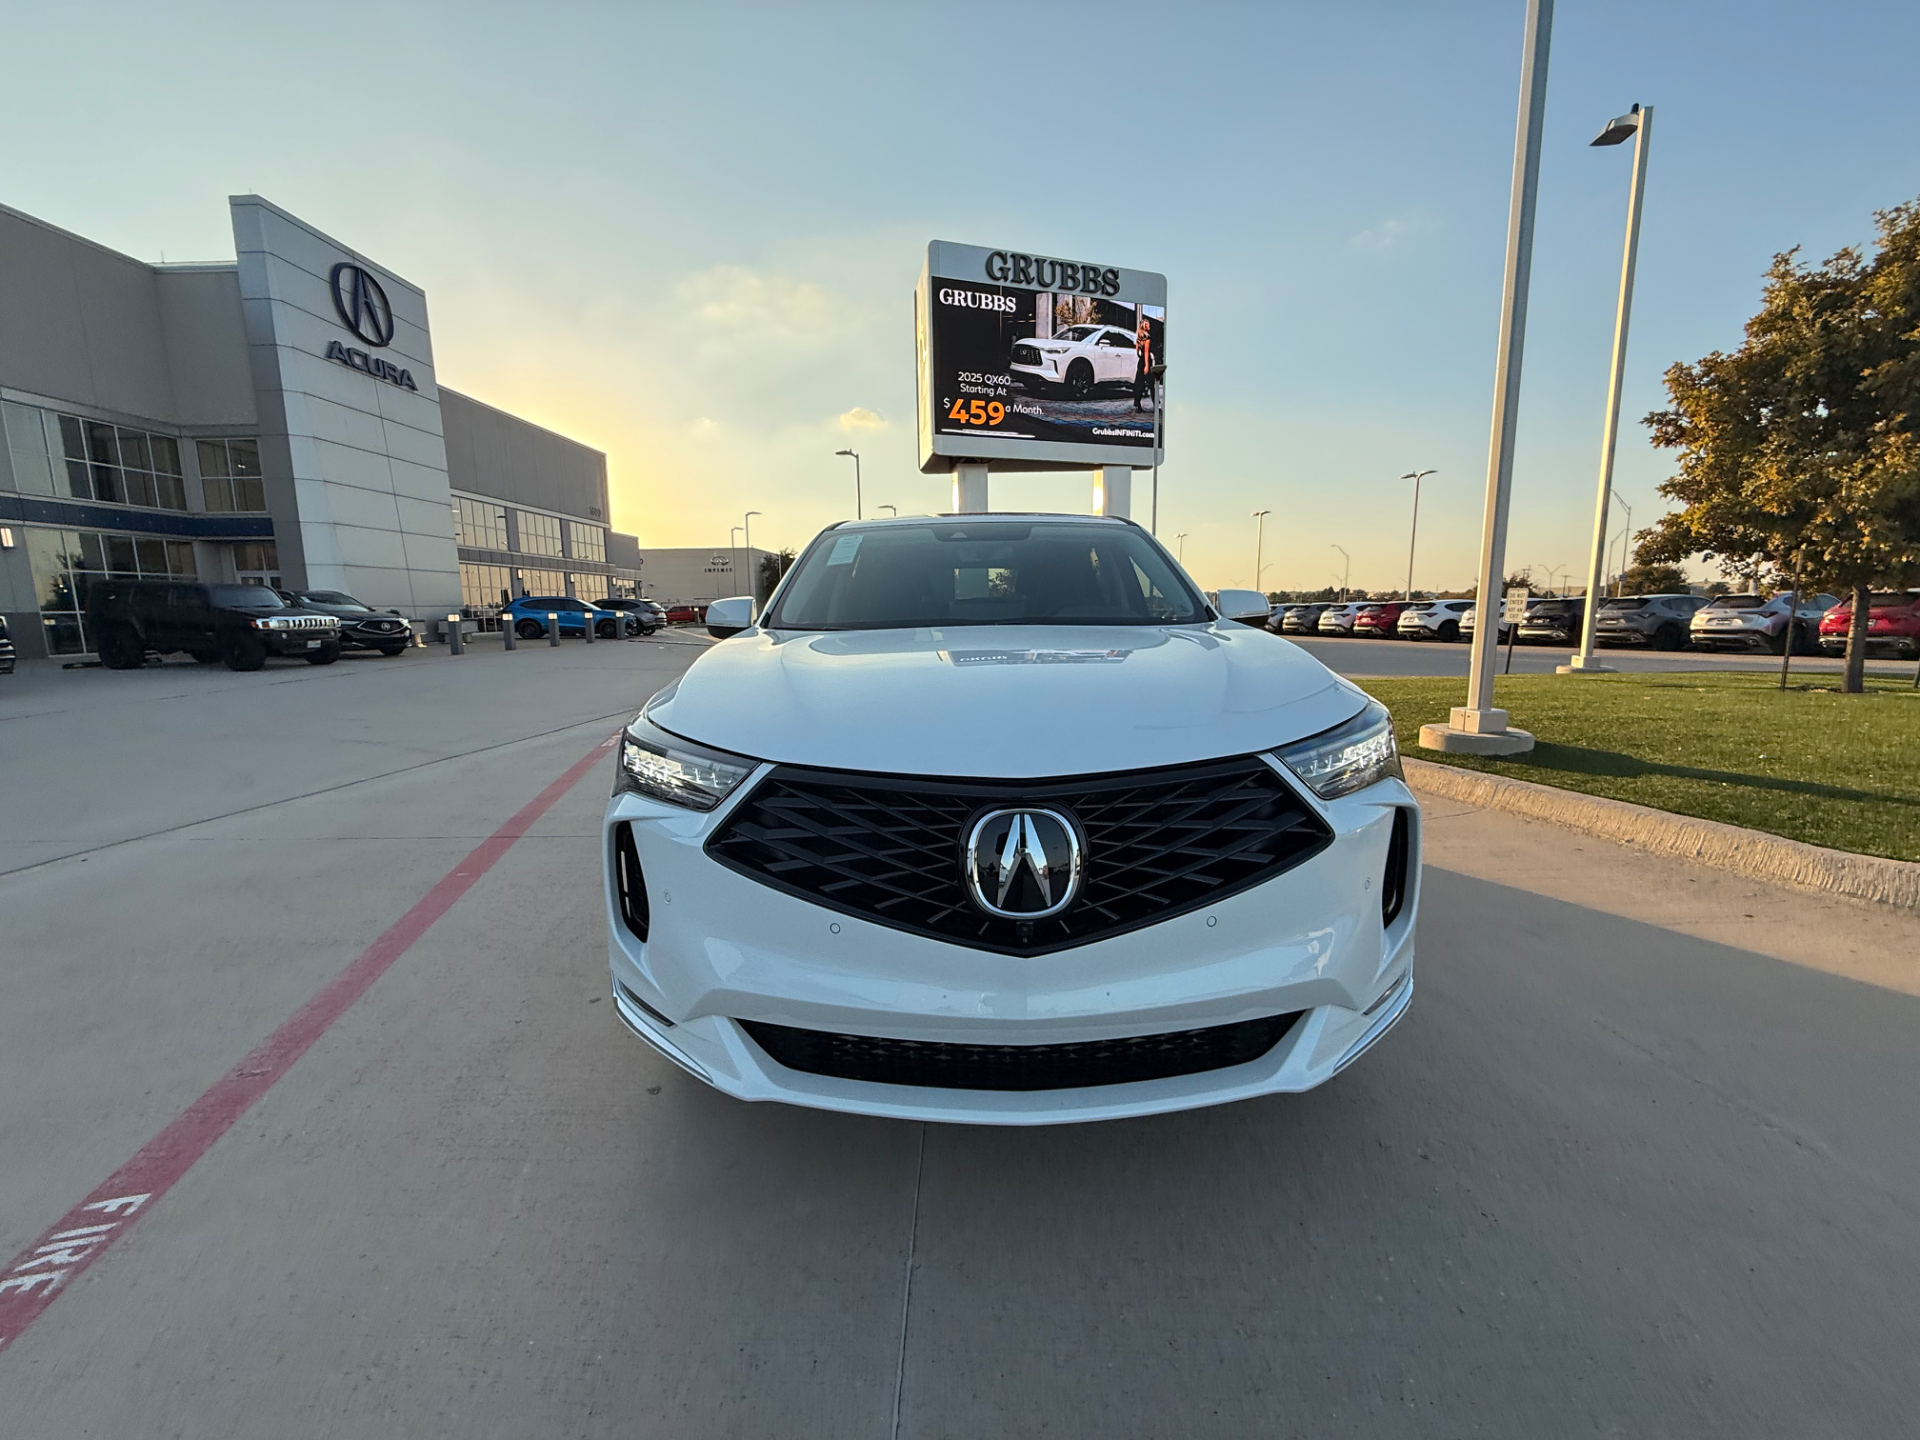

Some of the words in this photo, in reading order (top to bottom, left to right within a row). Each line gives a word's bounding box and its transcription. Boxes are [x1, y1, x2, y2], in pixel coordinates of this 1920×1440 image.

[985, 251, 1120, 297] GRUBBS
[939, 287, 1017, 313] GRUBBS
[325, 340, 418, 391] ACURA
[957, 371, 983, 383] 2025
[984, 374, 1011, 386] QX60
[960, 383, 995, 397] Starting
[996, 387, 1007, 396] At
[1005, 405, 1011, 413] a
[1013, 404, 1044, 415] Month.
[0, 1193, 151, 1298] FIRE
